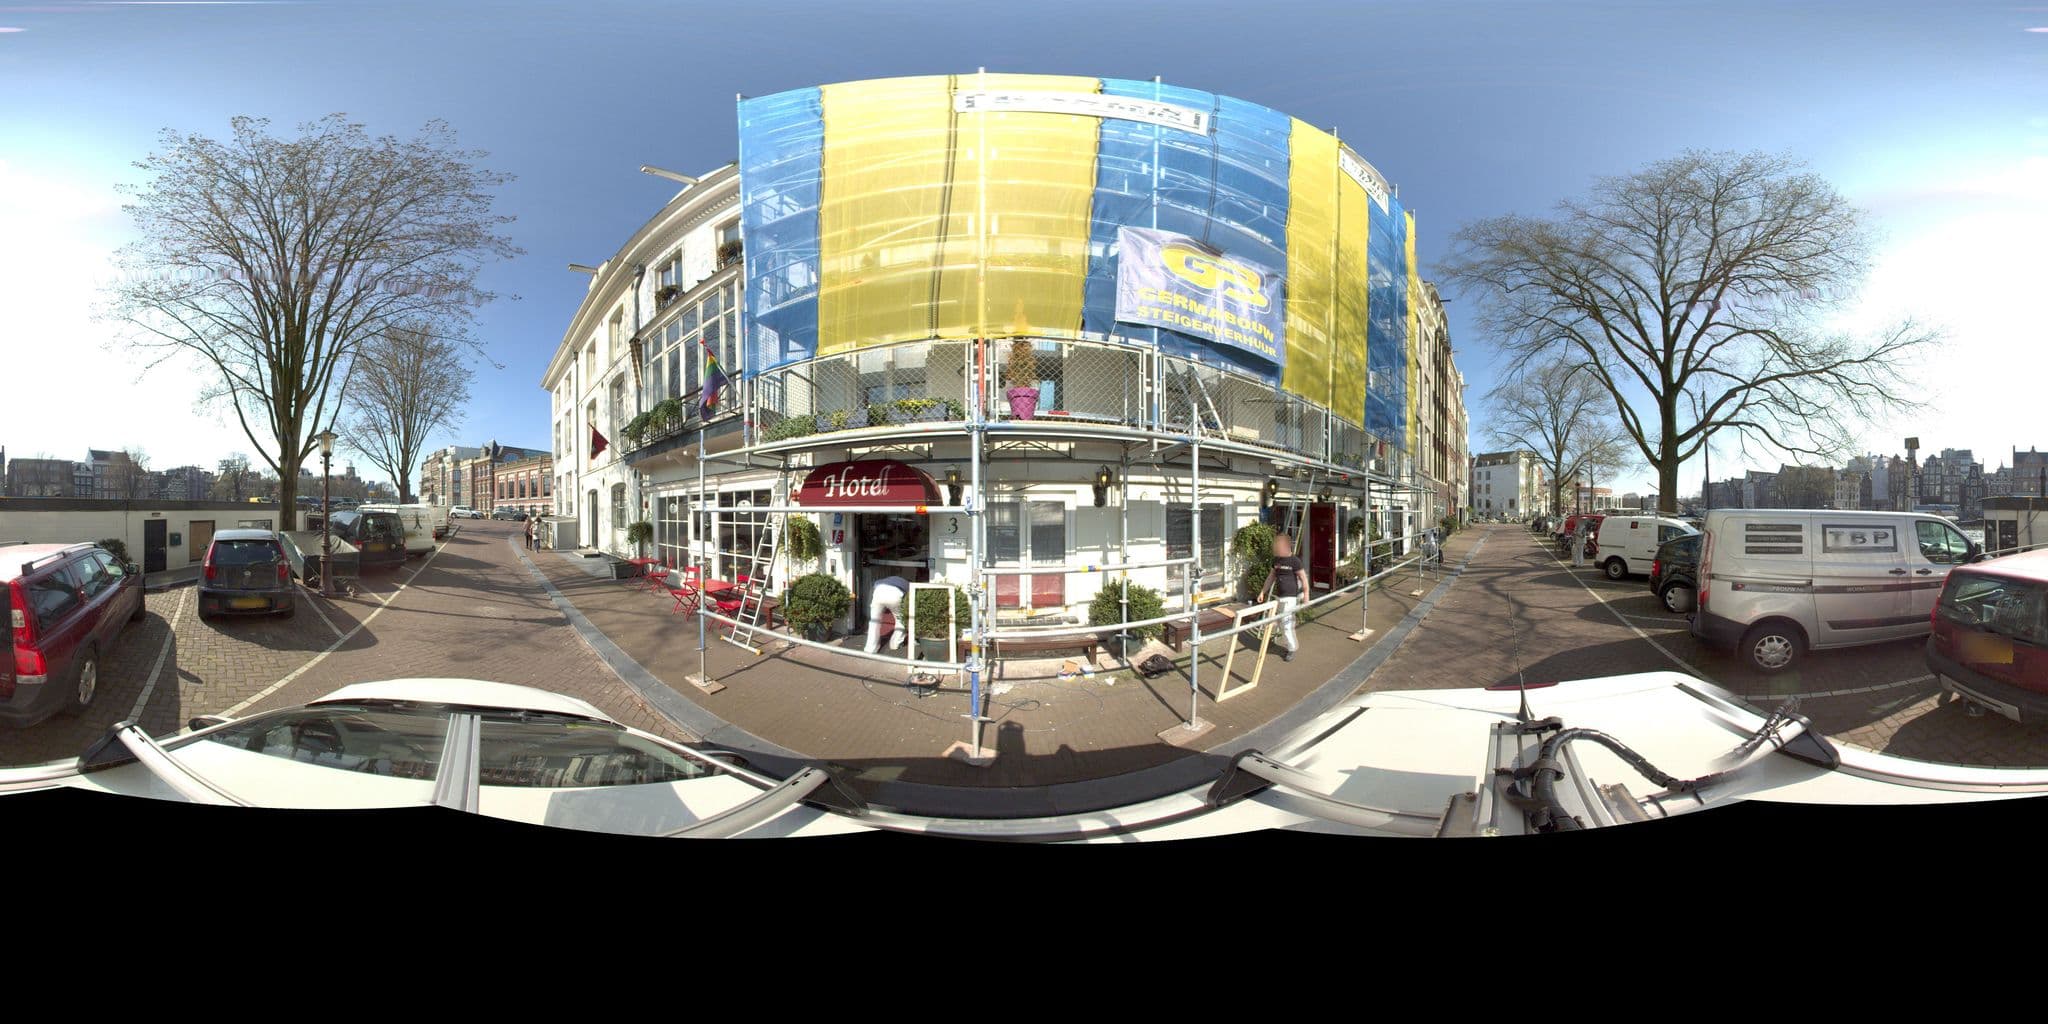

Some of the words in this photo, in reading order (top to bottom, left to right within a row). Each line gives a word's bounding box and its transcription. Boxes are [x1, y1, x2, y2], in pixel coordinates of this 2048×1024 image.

[1136, 304, 1278, 357] STEIGERVERHUUR
[1138, 286, 1275, 343] GERMABOUW
[824, 465, 896, 498] Hotel
[948, 517, 958, 533] 3
[1829, 531, 1890, 545] TBP
